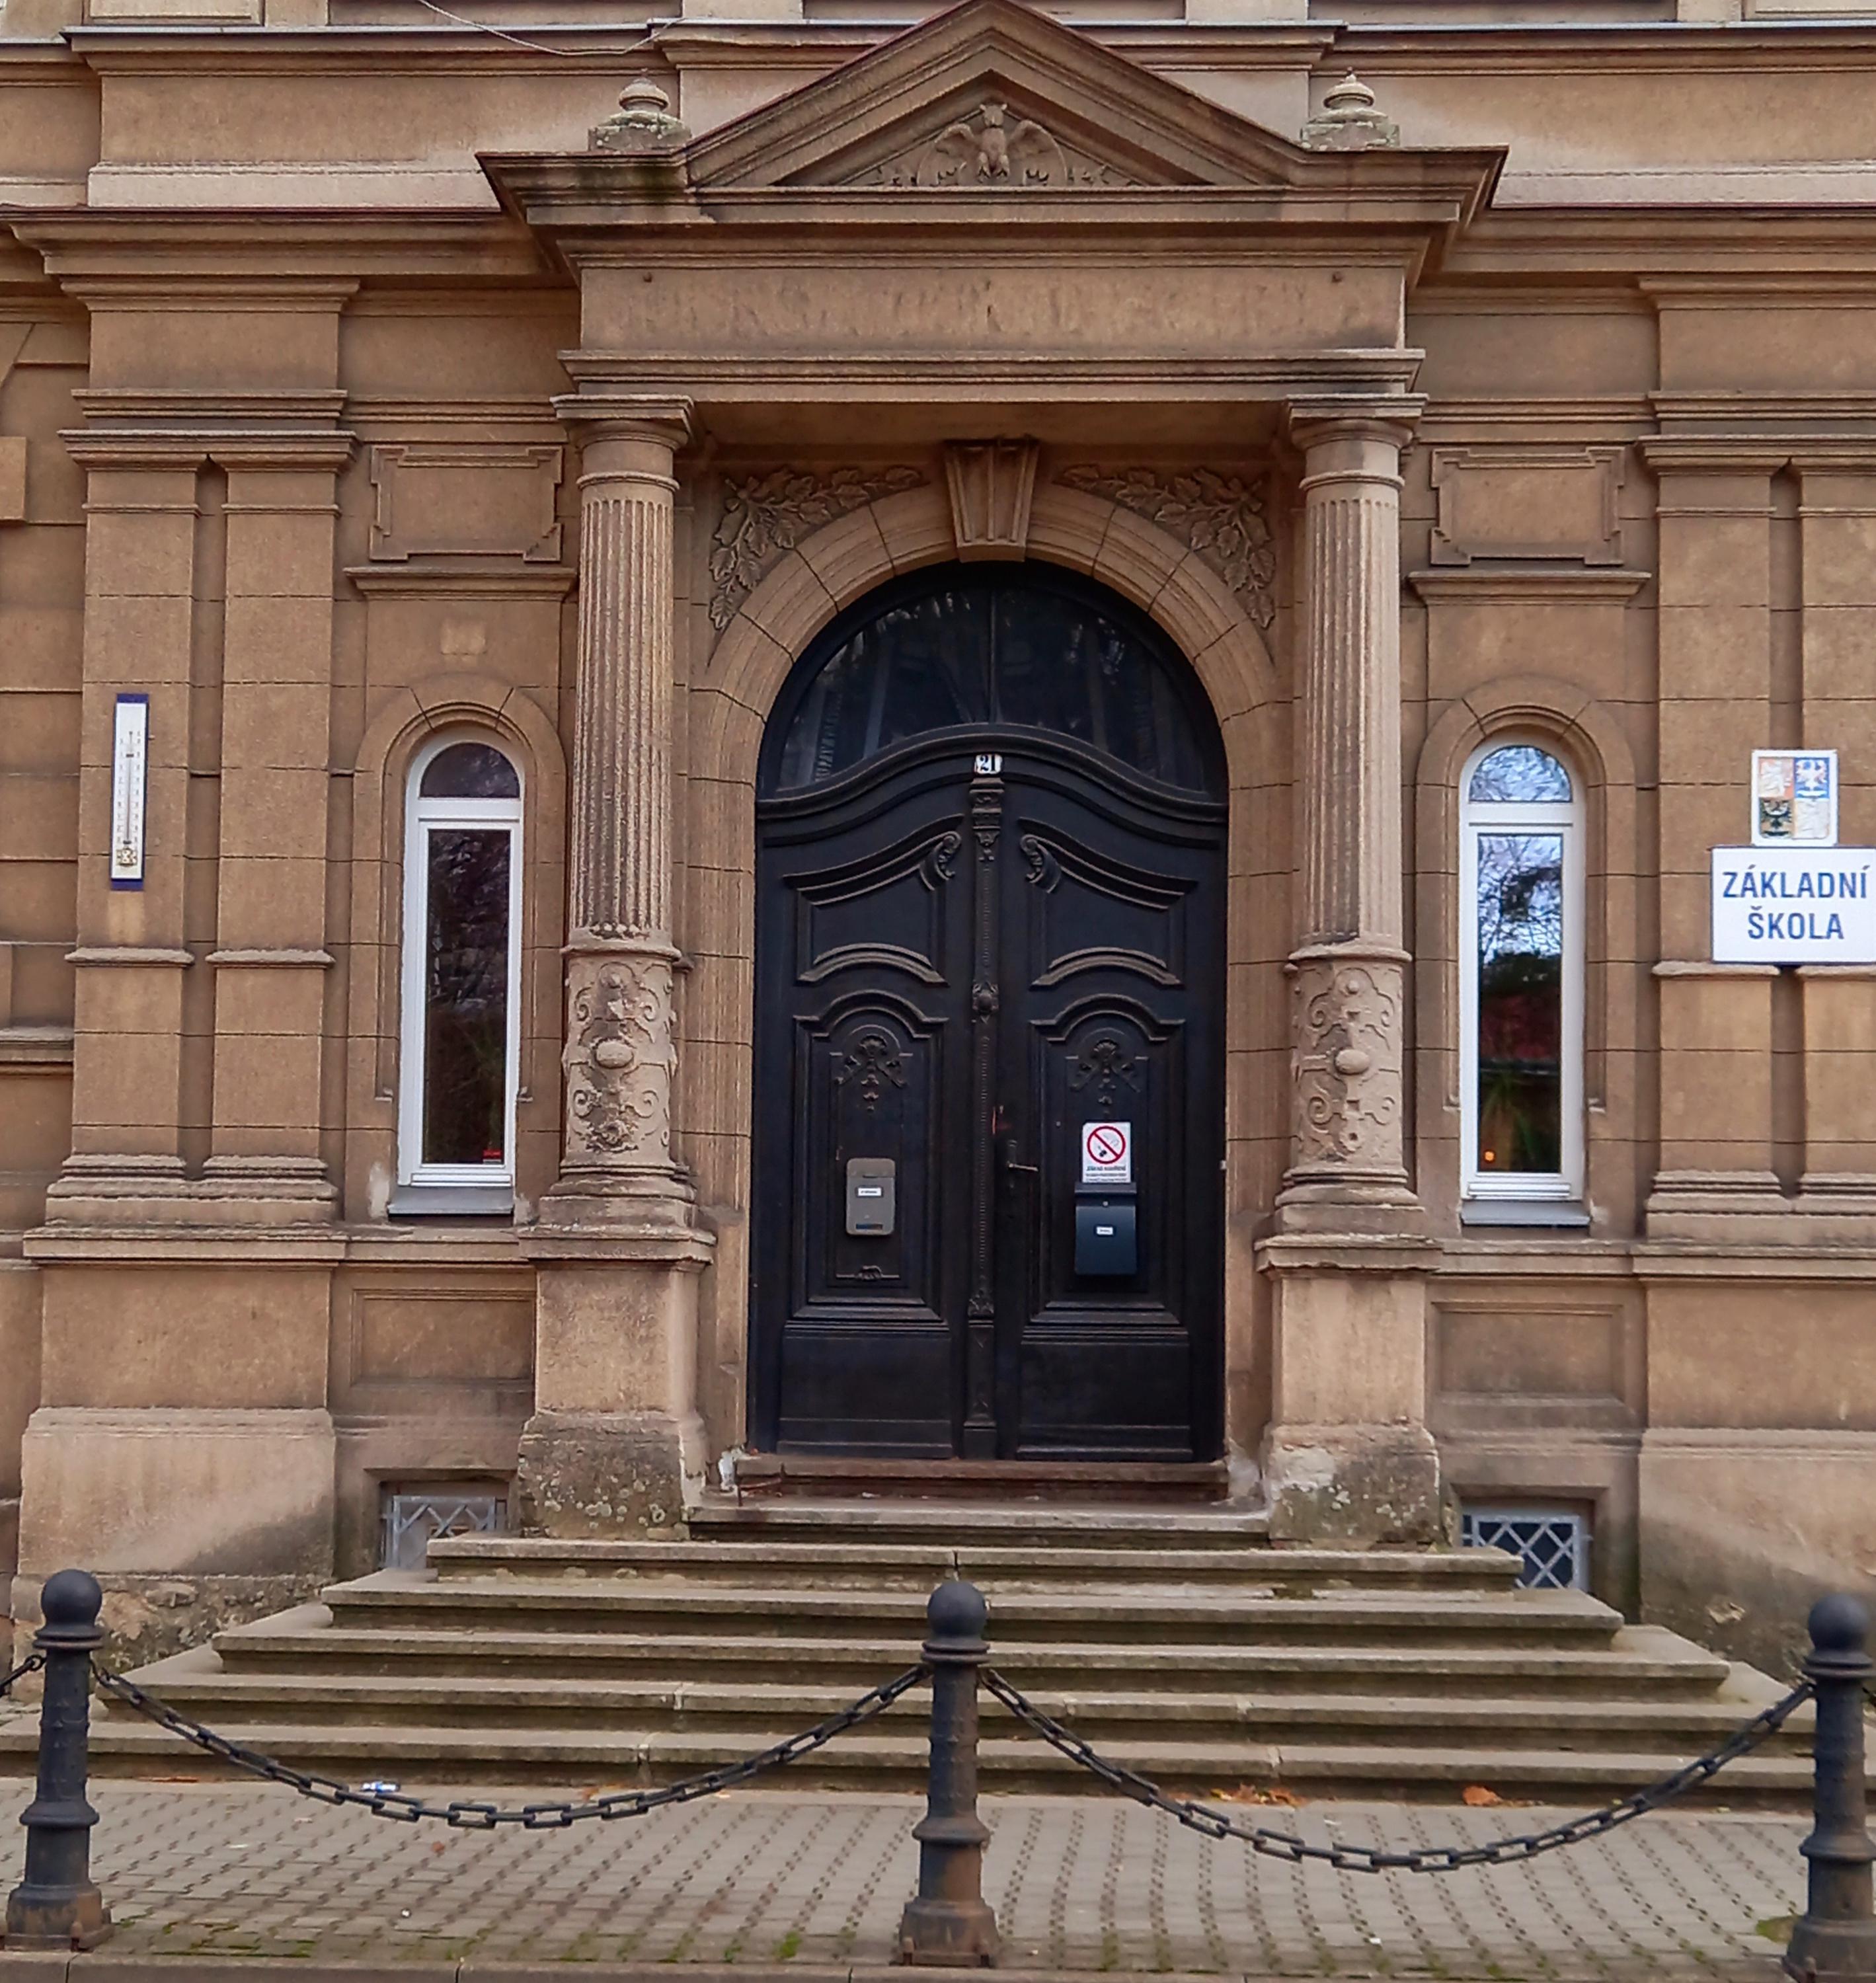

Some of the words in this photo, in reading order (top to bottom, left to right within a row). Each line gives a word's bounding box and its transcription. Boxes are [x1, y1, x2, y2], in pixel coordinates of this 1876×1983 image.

[980, 754, 996, 771] 21
[1722, 864, 1870, 898] ZÁKLADNÍ
[1747, 905, 1844, 939] ŠKOLA
